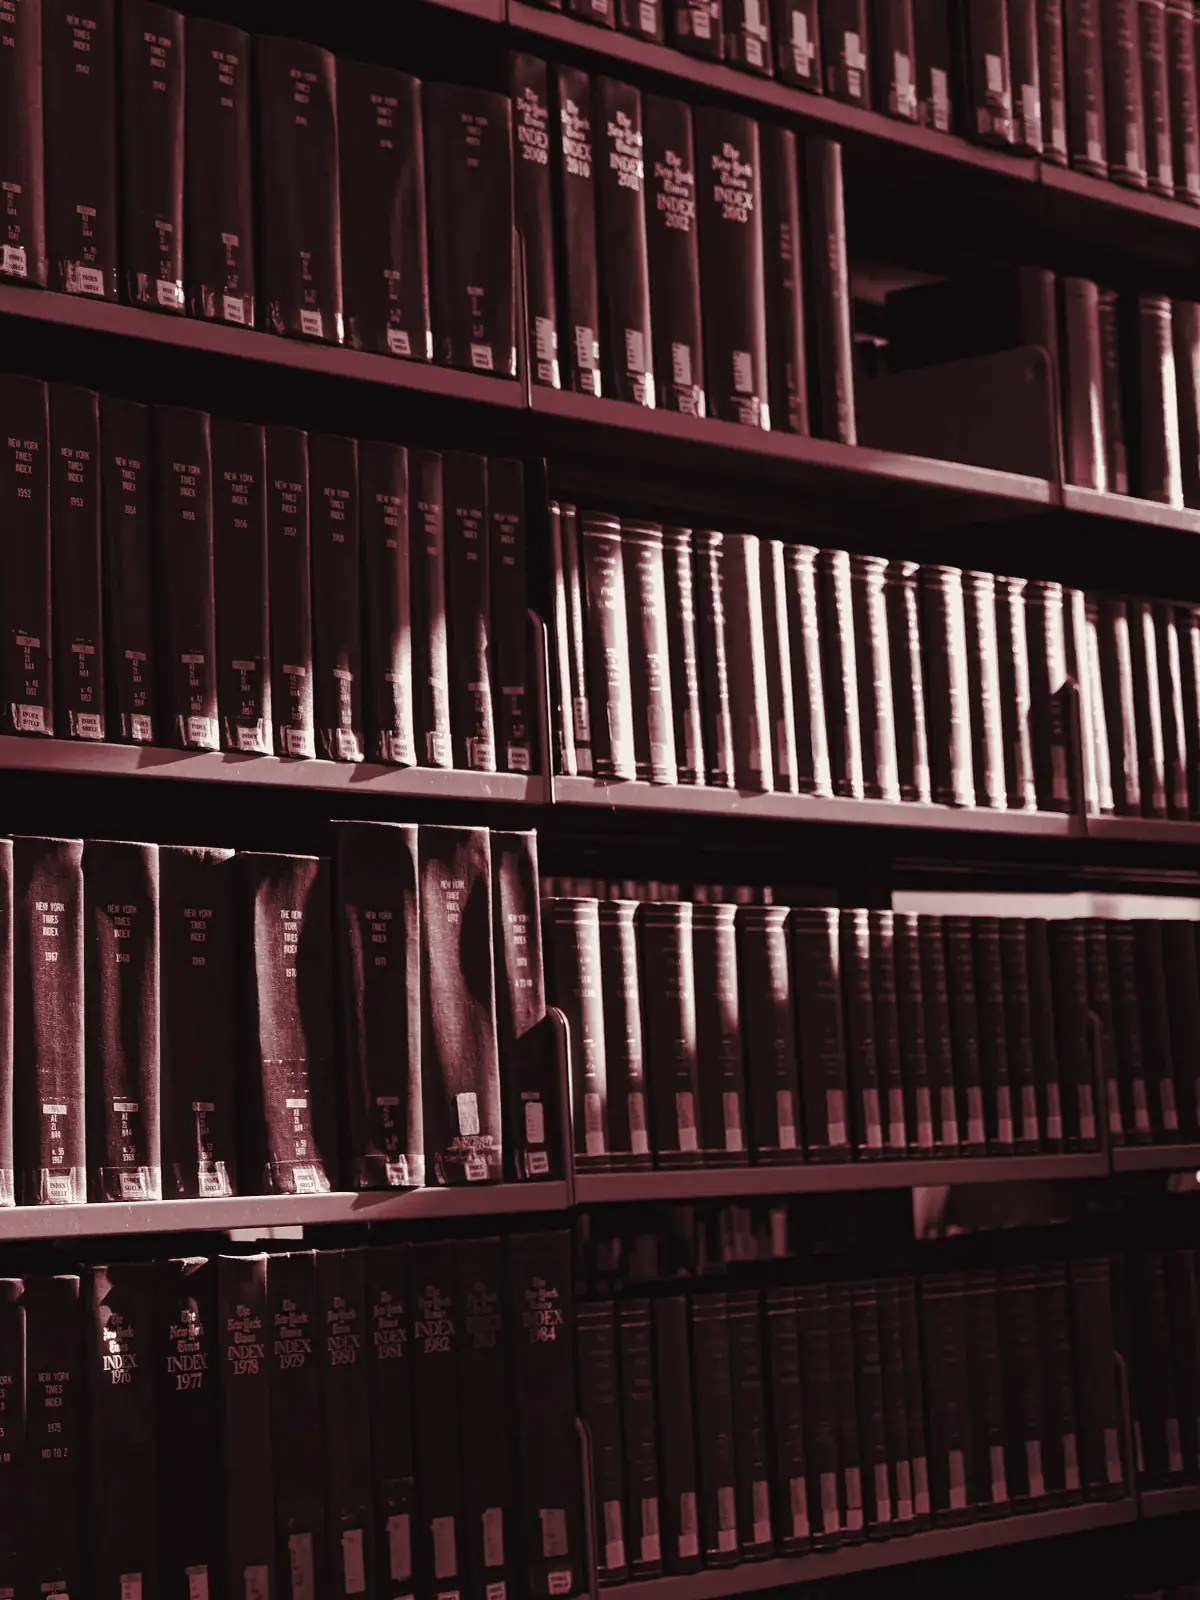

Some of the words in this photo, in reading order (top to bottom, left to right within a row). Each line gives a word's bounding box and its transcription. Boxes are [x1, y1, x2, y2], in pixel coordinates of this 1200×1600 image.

[656, 192, 696, 218] INDEX
[713, 184, 754, 211] INDEX
[8, 437, 21, 448] NEW
[23, 440, 40, 451] YORK
[15, 451, 33, 462] TIMES
[15, 463, 33, 474] INDEX
[17, 488, 33, 499] 1952
[35, 901, 48, 911] NEW
[50, 902, 65, 912] YORK
[42, 914, 59, 925] TIMES
[42, 926, 59, 937] INDEX
[45, 951, 58, 962] 1967
[414, 1319, 456, 1339] INDEX
[227, 1344, 265, 1361] INDEX
[423, 1336, 451, 1354] 1982
[166, 1353, 209, 1373] INDEX
[232, 1359, 260, 1375] 1978
[176, 1372, 205, 1391] 1977
